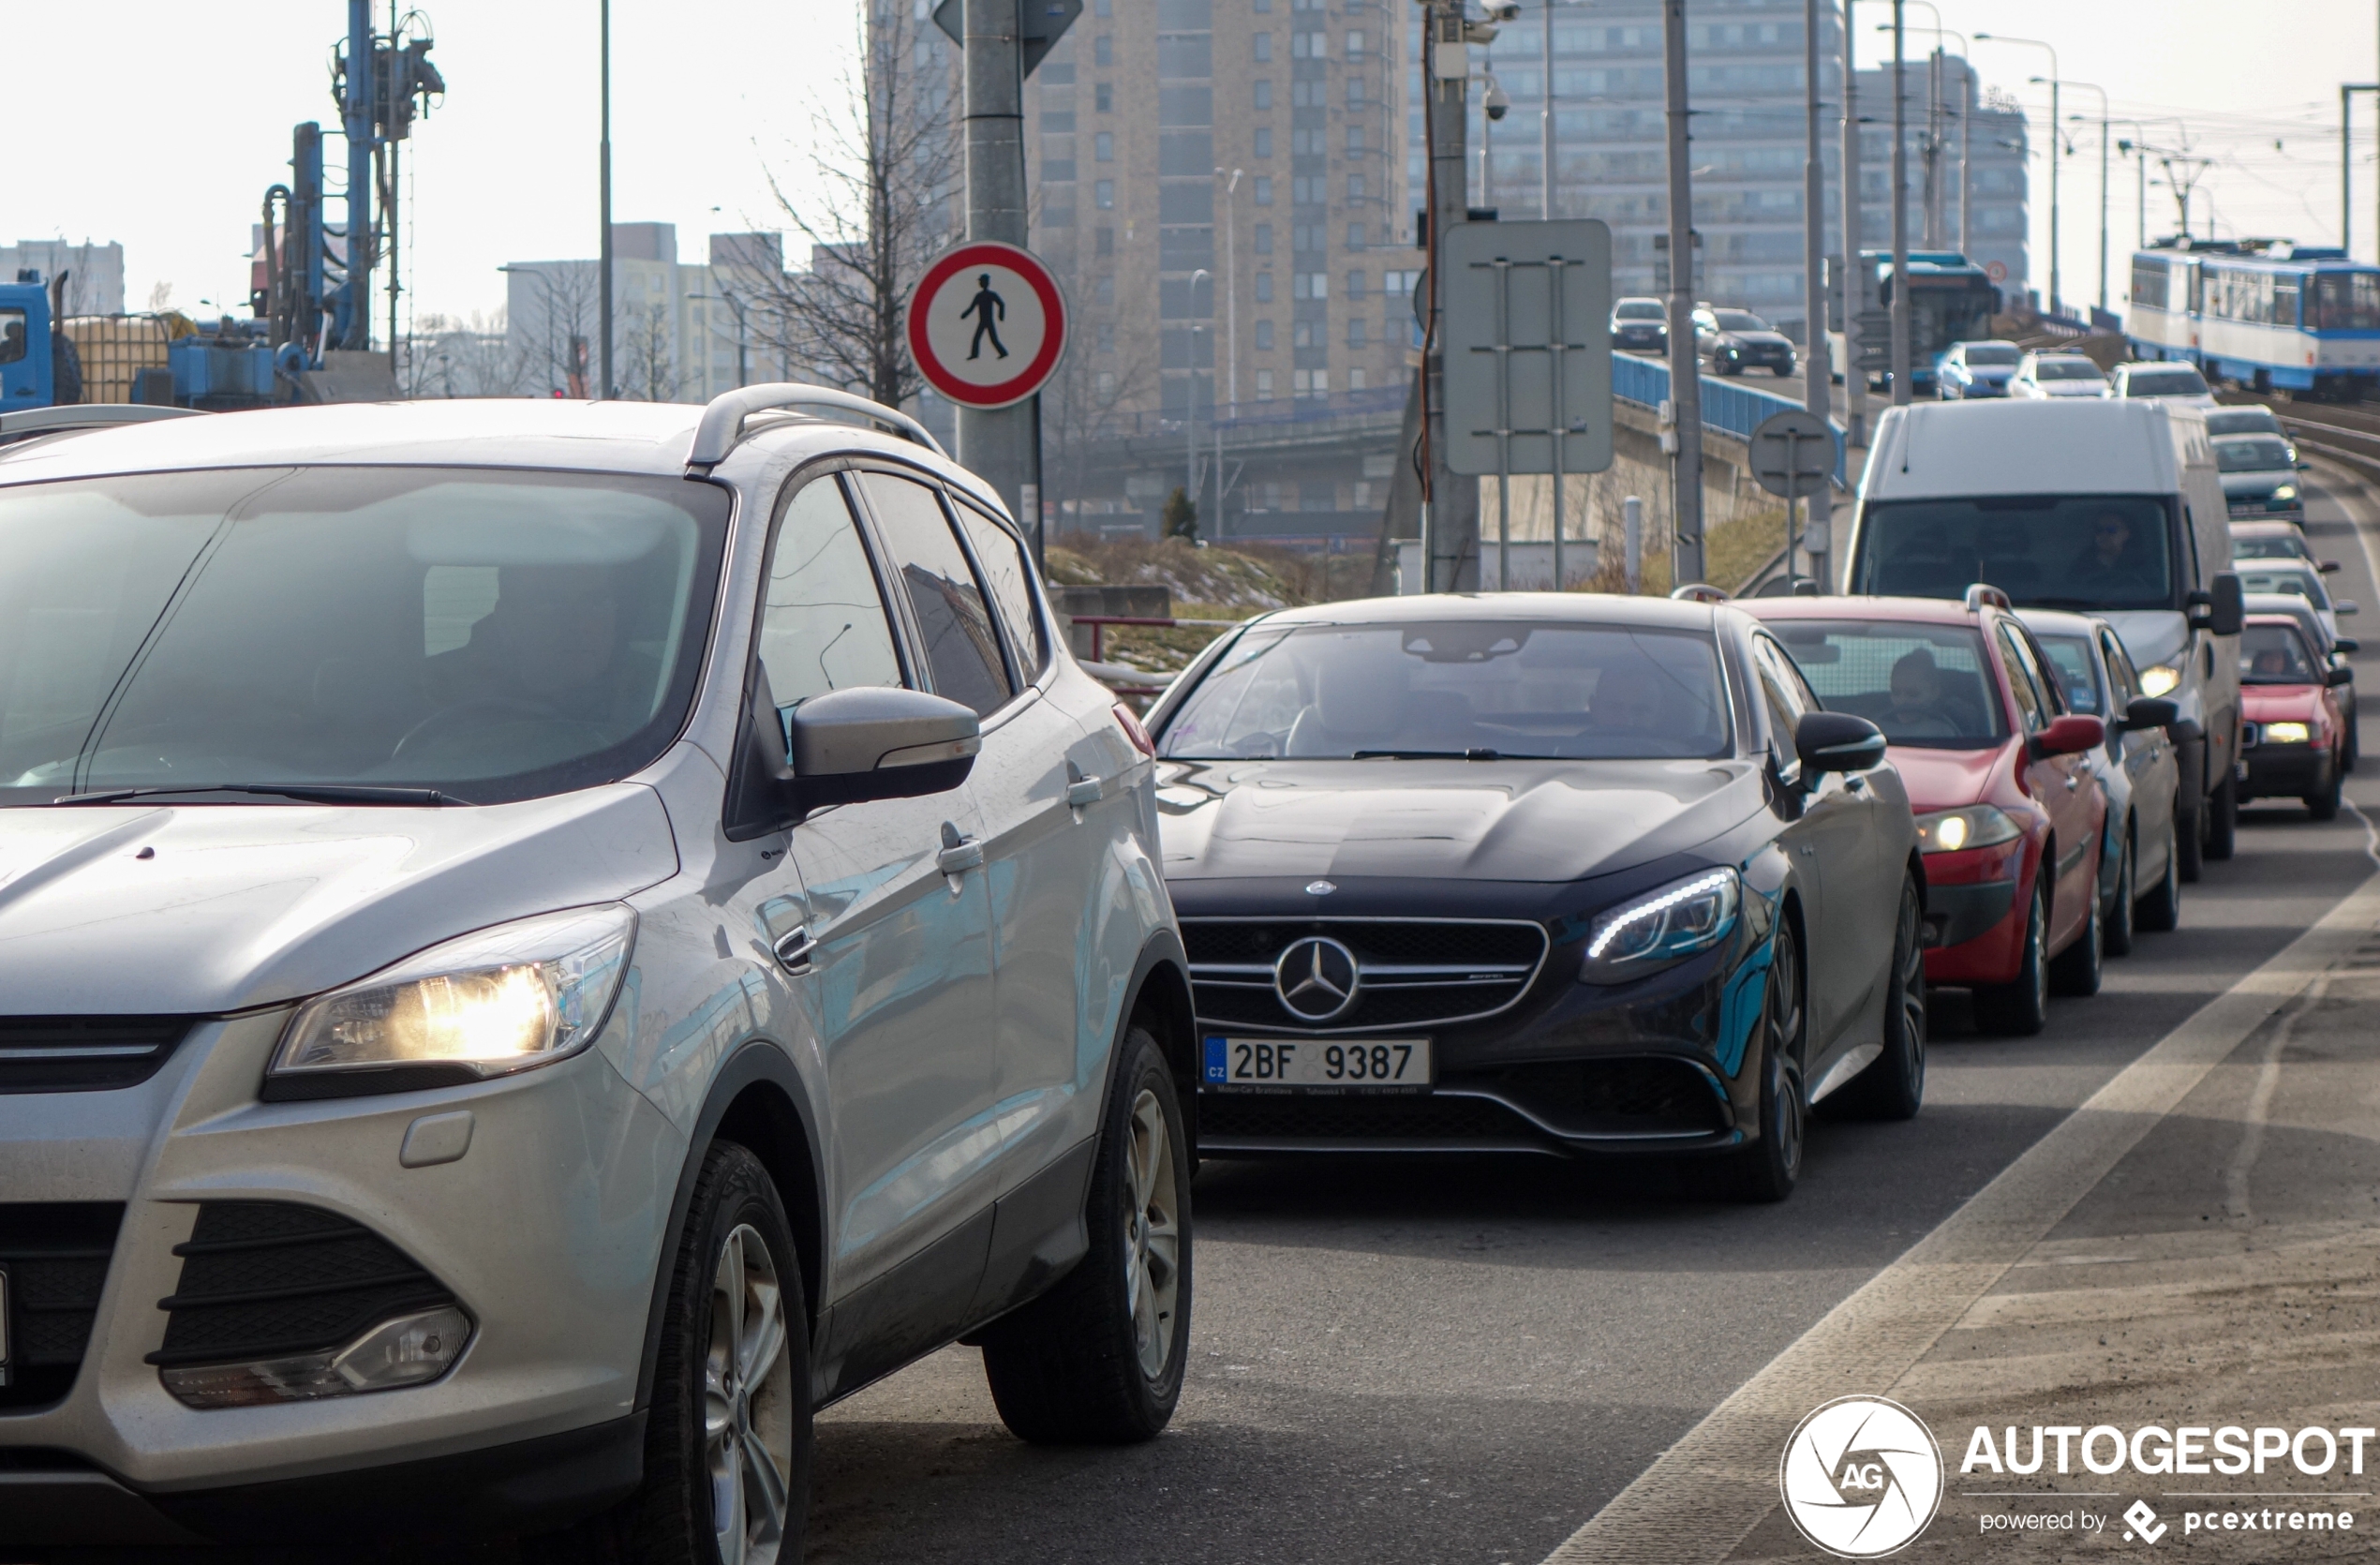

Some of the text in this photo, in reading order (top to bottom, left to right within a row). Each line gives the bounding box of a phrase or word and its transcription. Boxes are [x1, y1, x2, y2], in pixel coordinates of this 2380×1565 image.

[1209, 1066, 1225, 1078] CZ
[1234, 1044, 1413, 1080] 2BF 9387
